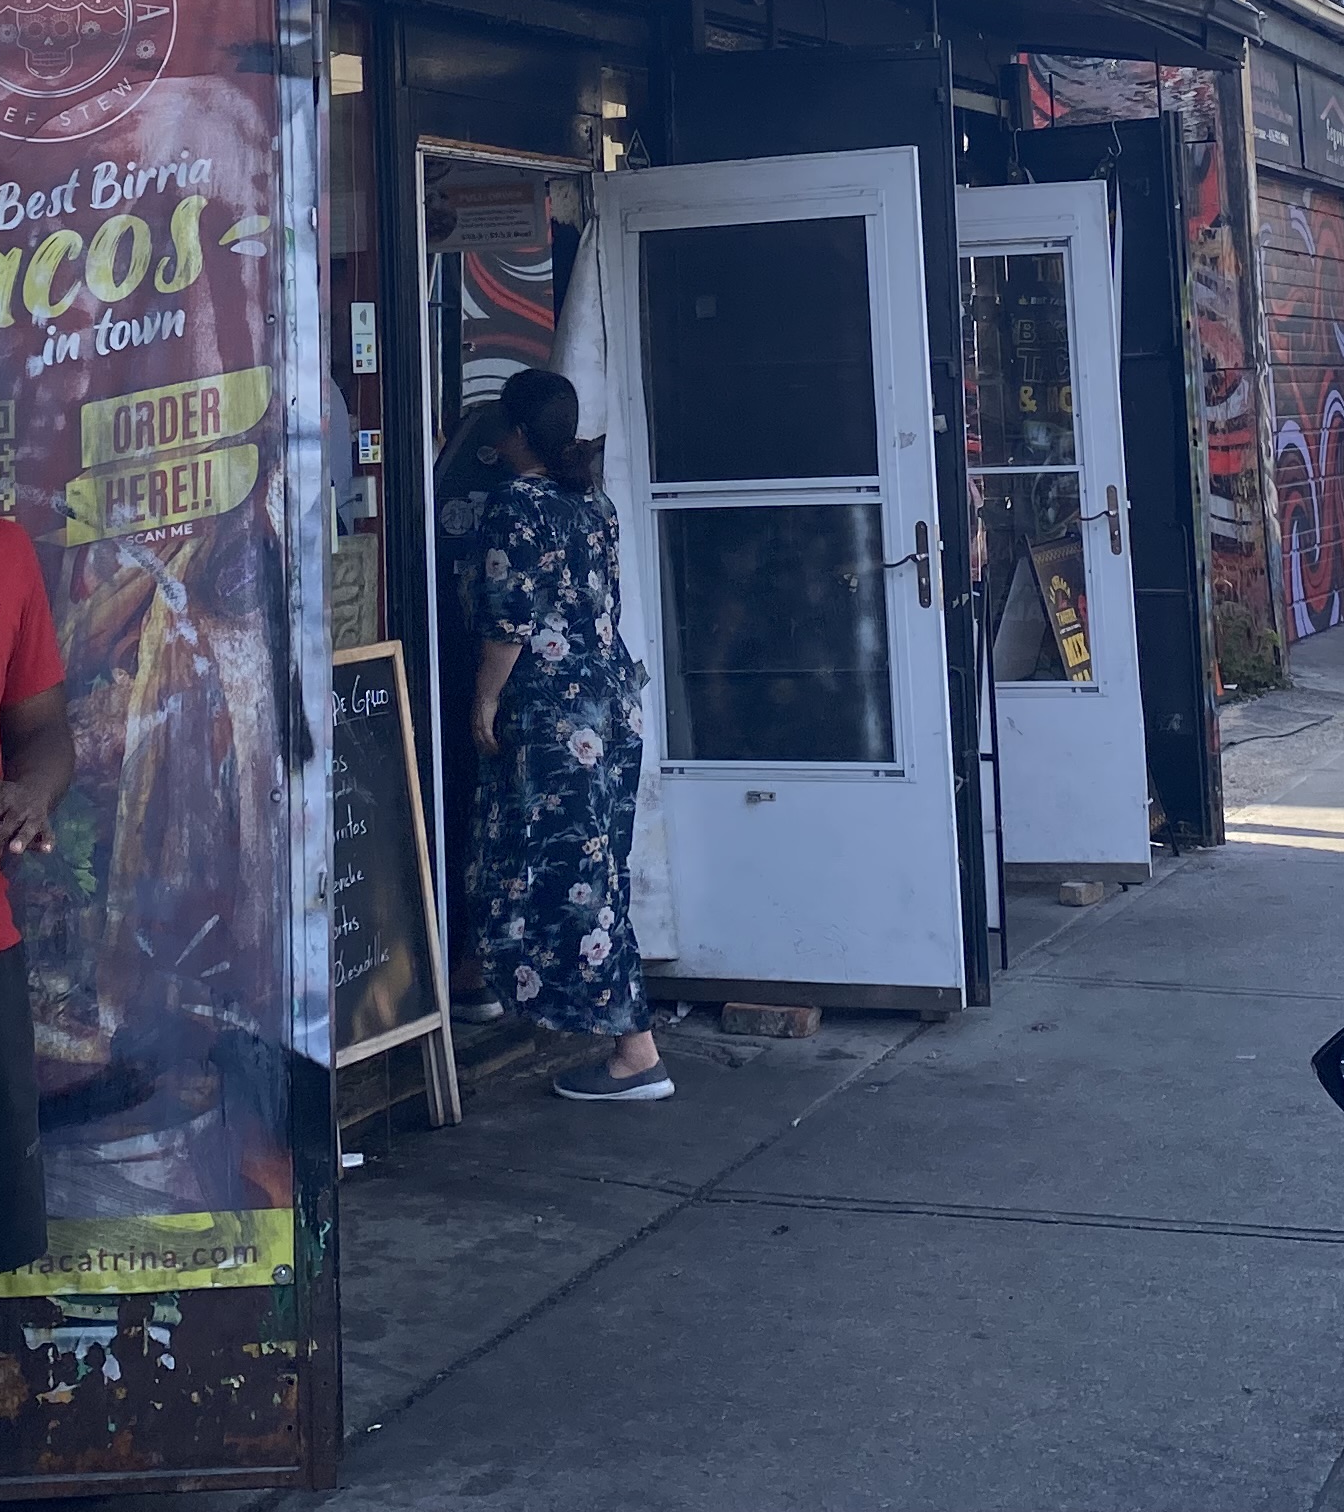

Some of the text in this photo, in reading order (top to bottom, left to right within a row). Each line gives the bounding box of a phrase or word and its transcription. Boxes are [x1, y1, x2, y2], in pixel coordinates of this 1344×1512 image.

[59, 76, 134, 127] STEW
[89, 152, 213, 211] Birria
[41, 305, 186, 368] in town
[112, 385, 221, 456] ORDER
[104, 458, 213, 522] HERE!!
[124, 522, 194, 546] SCAN ME
